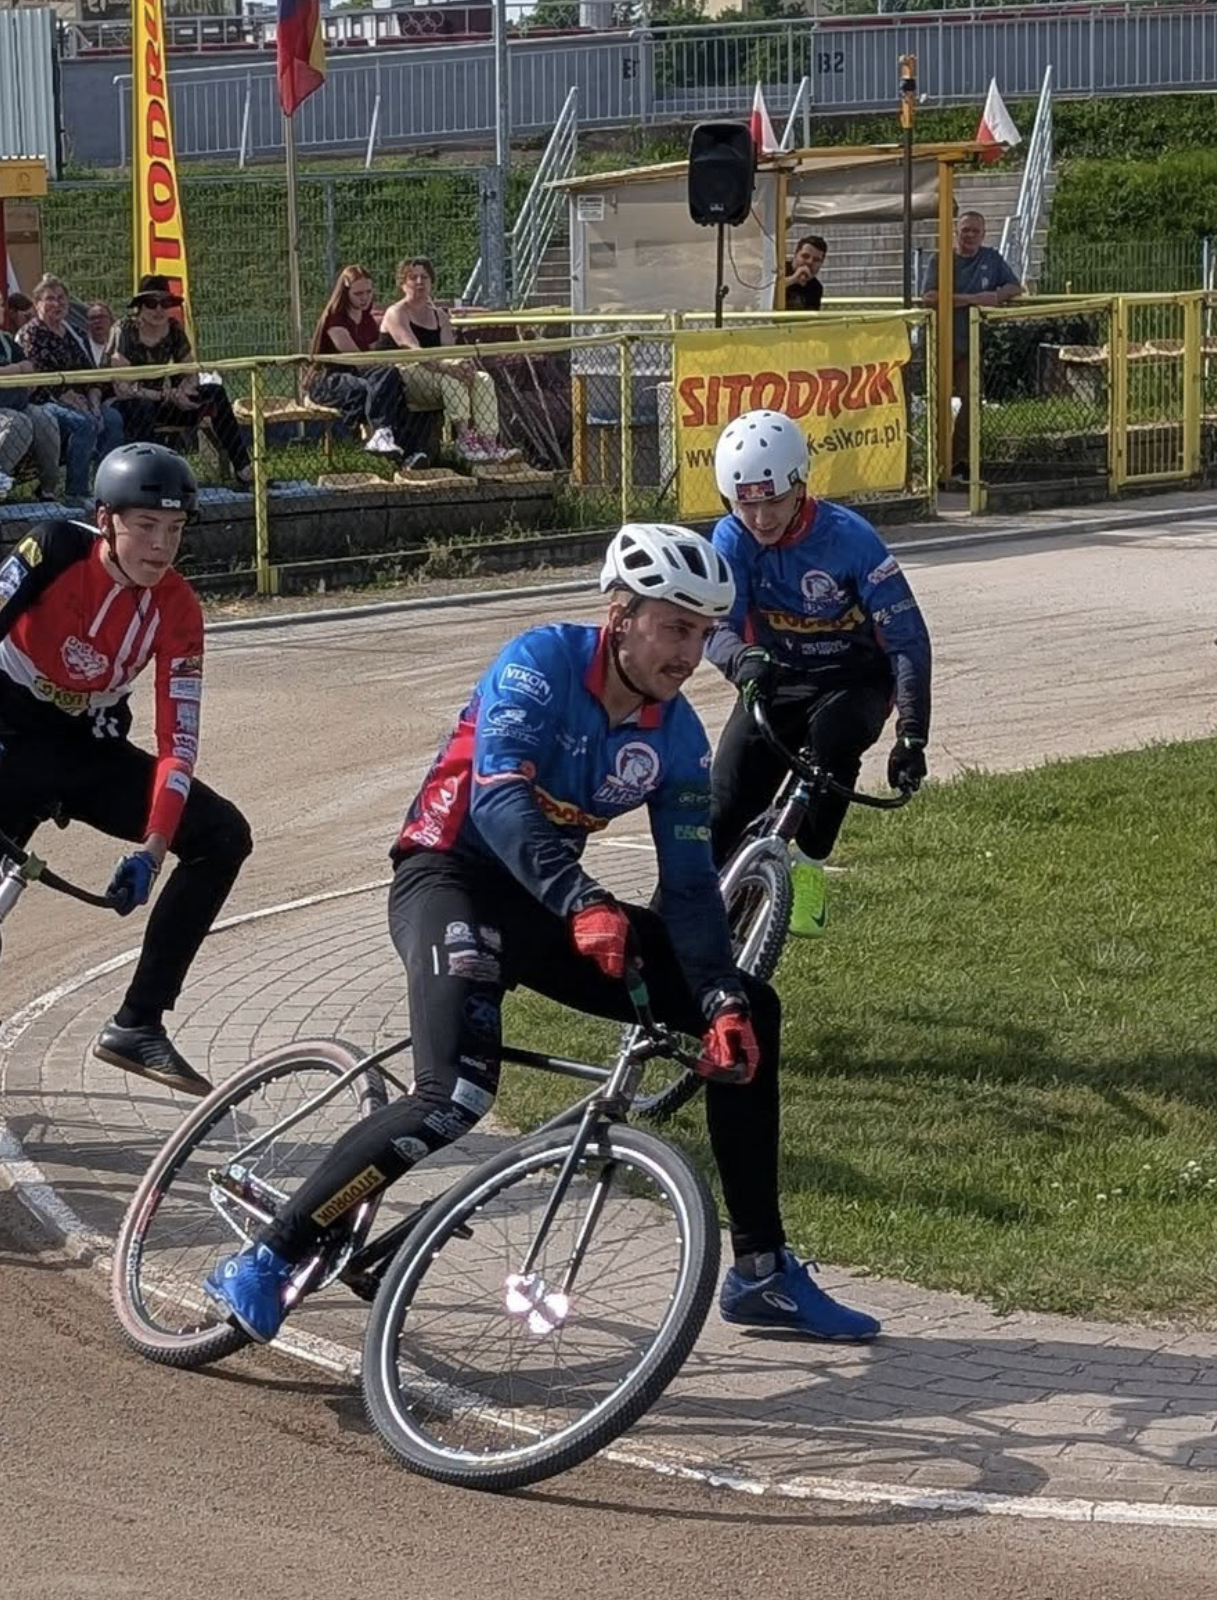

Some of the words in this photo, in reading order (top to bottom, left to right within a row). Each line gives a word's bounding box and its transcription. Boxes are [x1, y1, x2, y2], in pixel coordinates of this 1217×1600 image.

[818, 52, 844, 74] B2
[678, 359, 905, 428] SITODRUK
[506, 667, 551, 696] VIXON
[316, 1169, 381, 1225] SITODRUK
